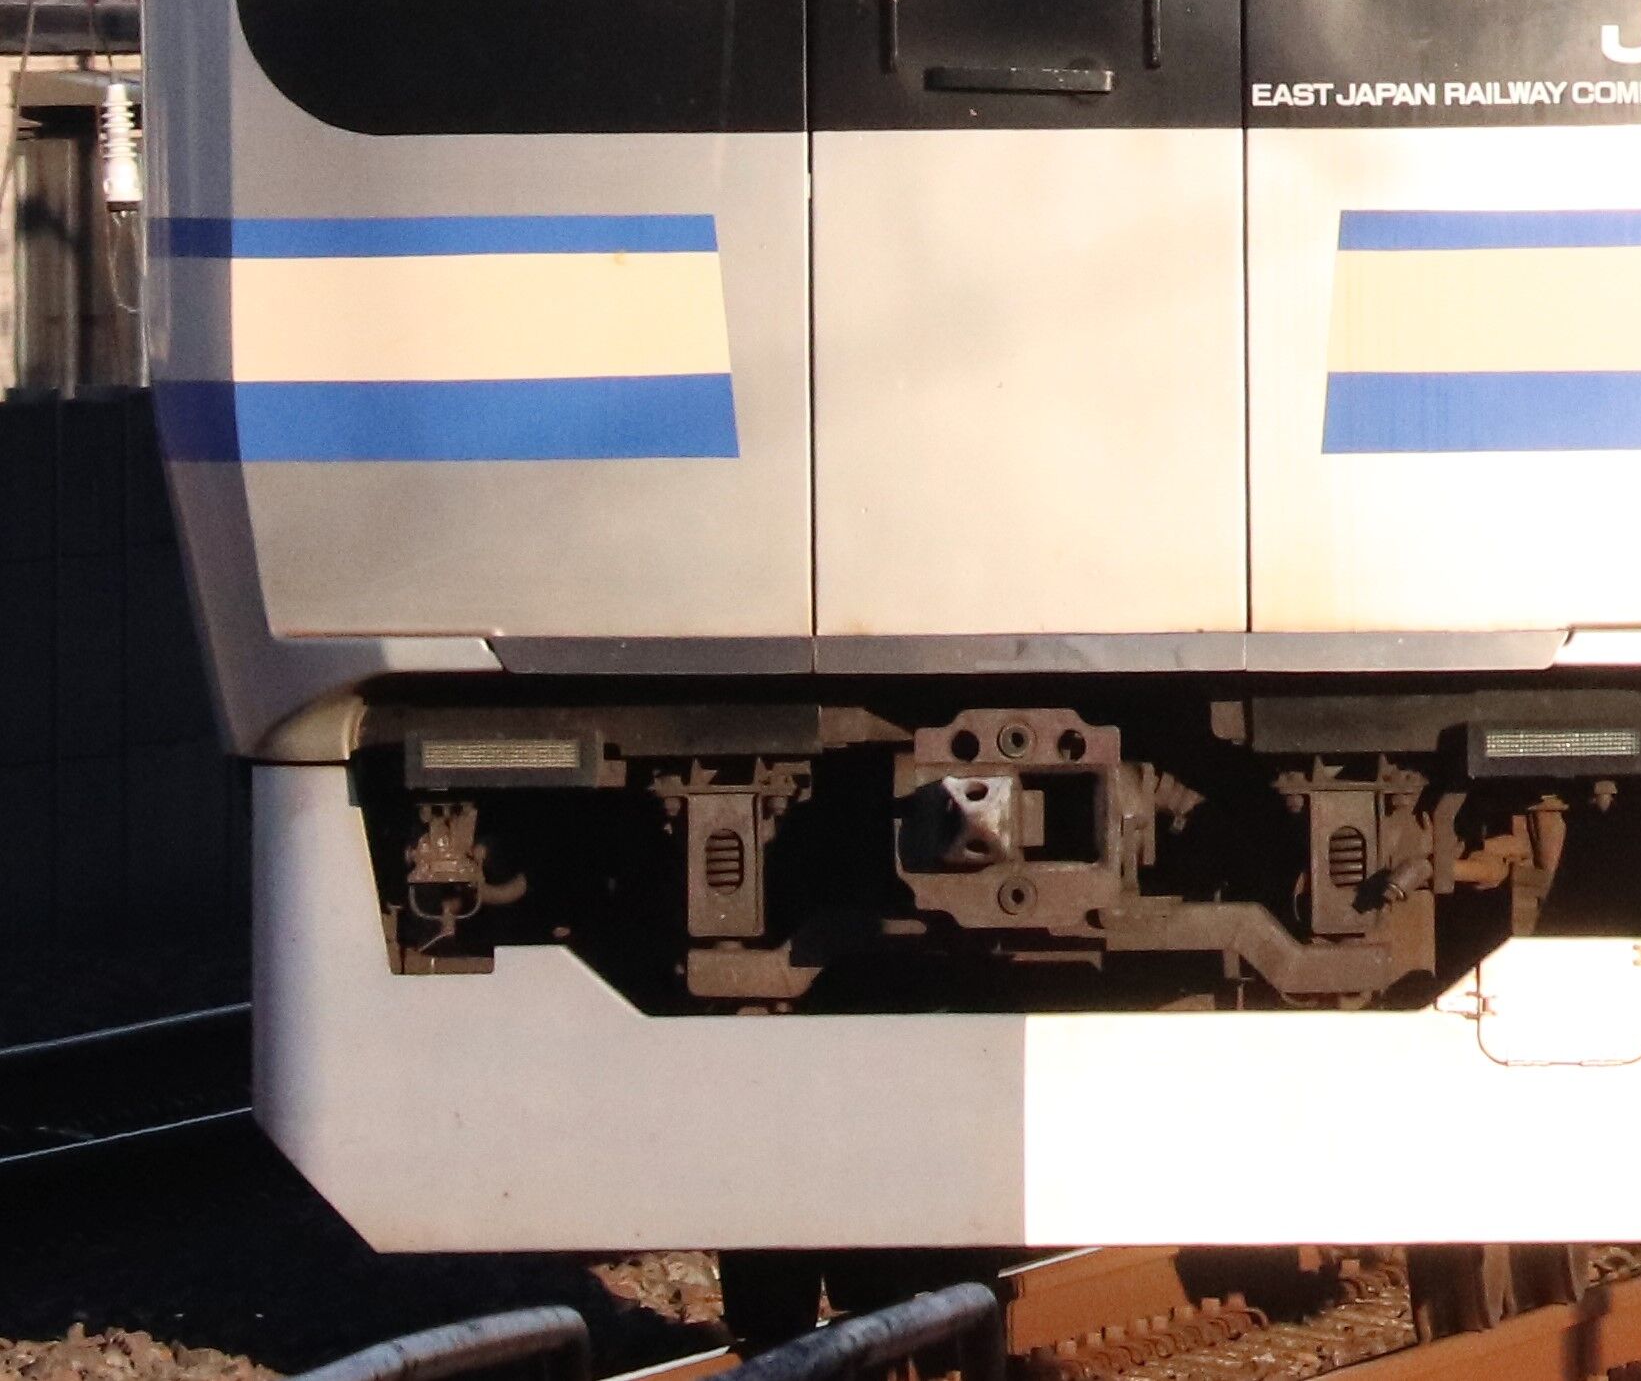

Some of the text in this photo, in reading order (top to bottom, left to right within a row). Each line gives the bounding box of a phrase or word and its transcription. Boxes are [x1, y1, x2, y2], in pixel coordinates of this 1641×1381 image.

[1252, 83, 1334, 107] EAST
[1336, 82, 1436, 106] JAPAN
[1444, 81, 1568, 106] RAILWAY
